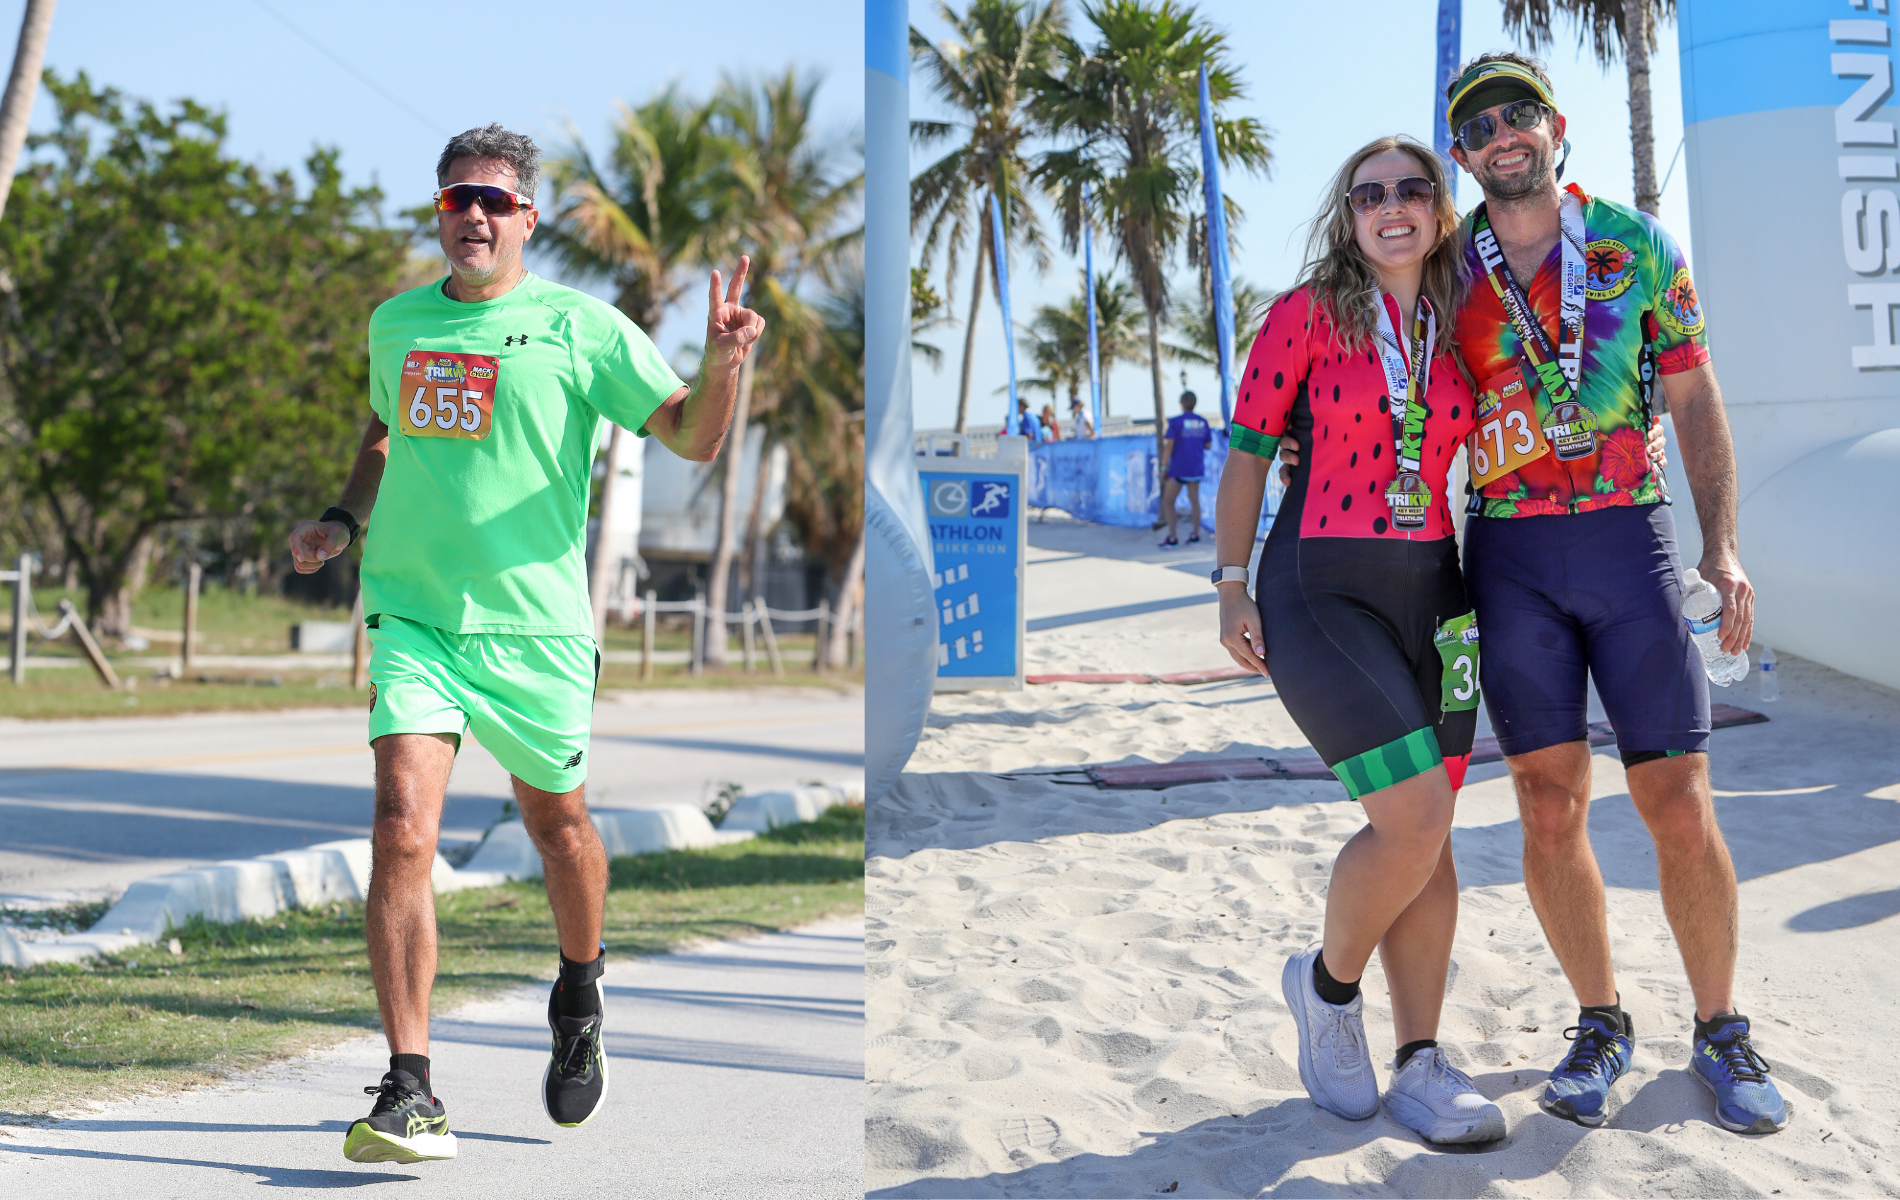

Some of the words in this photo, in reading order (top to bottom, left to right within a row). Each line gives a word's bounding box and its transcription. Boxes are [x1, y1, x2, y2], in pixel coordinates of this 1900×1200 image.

[1829, 0, 1900, 372] INISH
[1504, 288, 1535, 342] TRIATHLON
[427, 366, 465, 378] TRIKW
[1385, 356, 1399, 393] INTEGRITY
[408, 386, 483, 432] 655
[1474, 409, 1535, 476] 673
[1543, 419, 1598, 439] TRIKW
[1558, 436, 1570, 444] KEY
[1572, 433, 1588, 442] WEST
[1558, 441, 1592, 452] TRIATHLON
[1385, 493, 1432, 507] TRIKW
